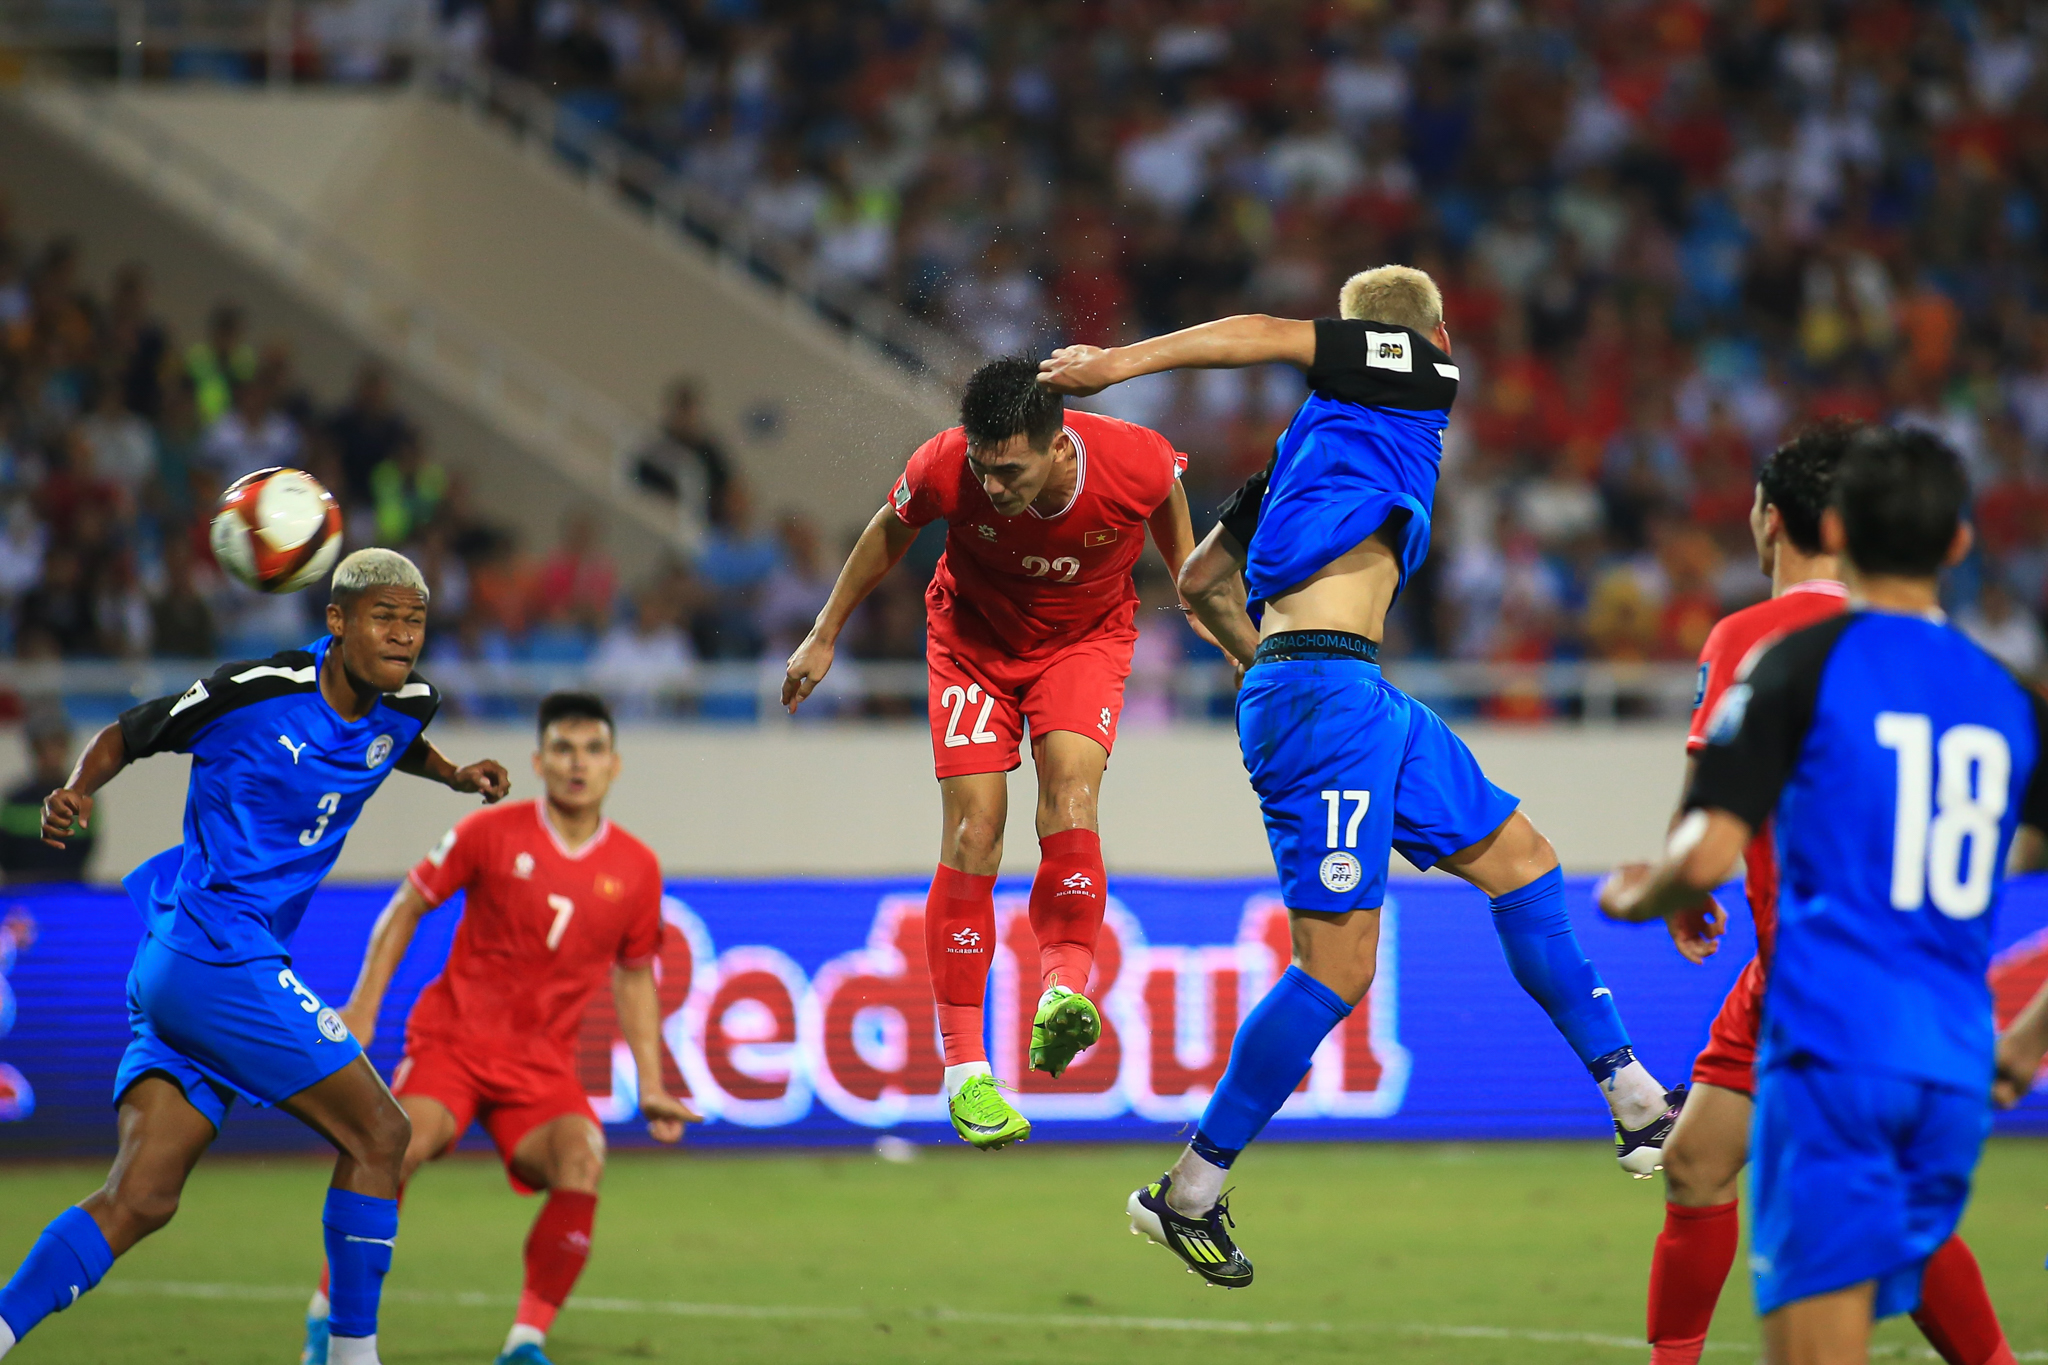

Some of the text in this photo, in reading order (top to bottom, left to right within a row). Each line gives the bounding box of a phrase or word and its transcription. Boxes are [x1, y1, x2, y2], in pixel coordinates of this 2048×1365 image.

[1022, 555, 1080, 583] 22
[941, 682, 997, 748] 22
[298, 791, 342, 847] 3
[1320, 789, 1371, 849] 17
[1874, 711, 2011, 920] 18
[1331, 873, 1353, 882] PFF
[546, 893, 575, 950] 7
[277, 968, 321, 1014] 3
